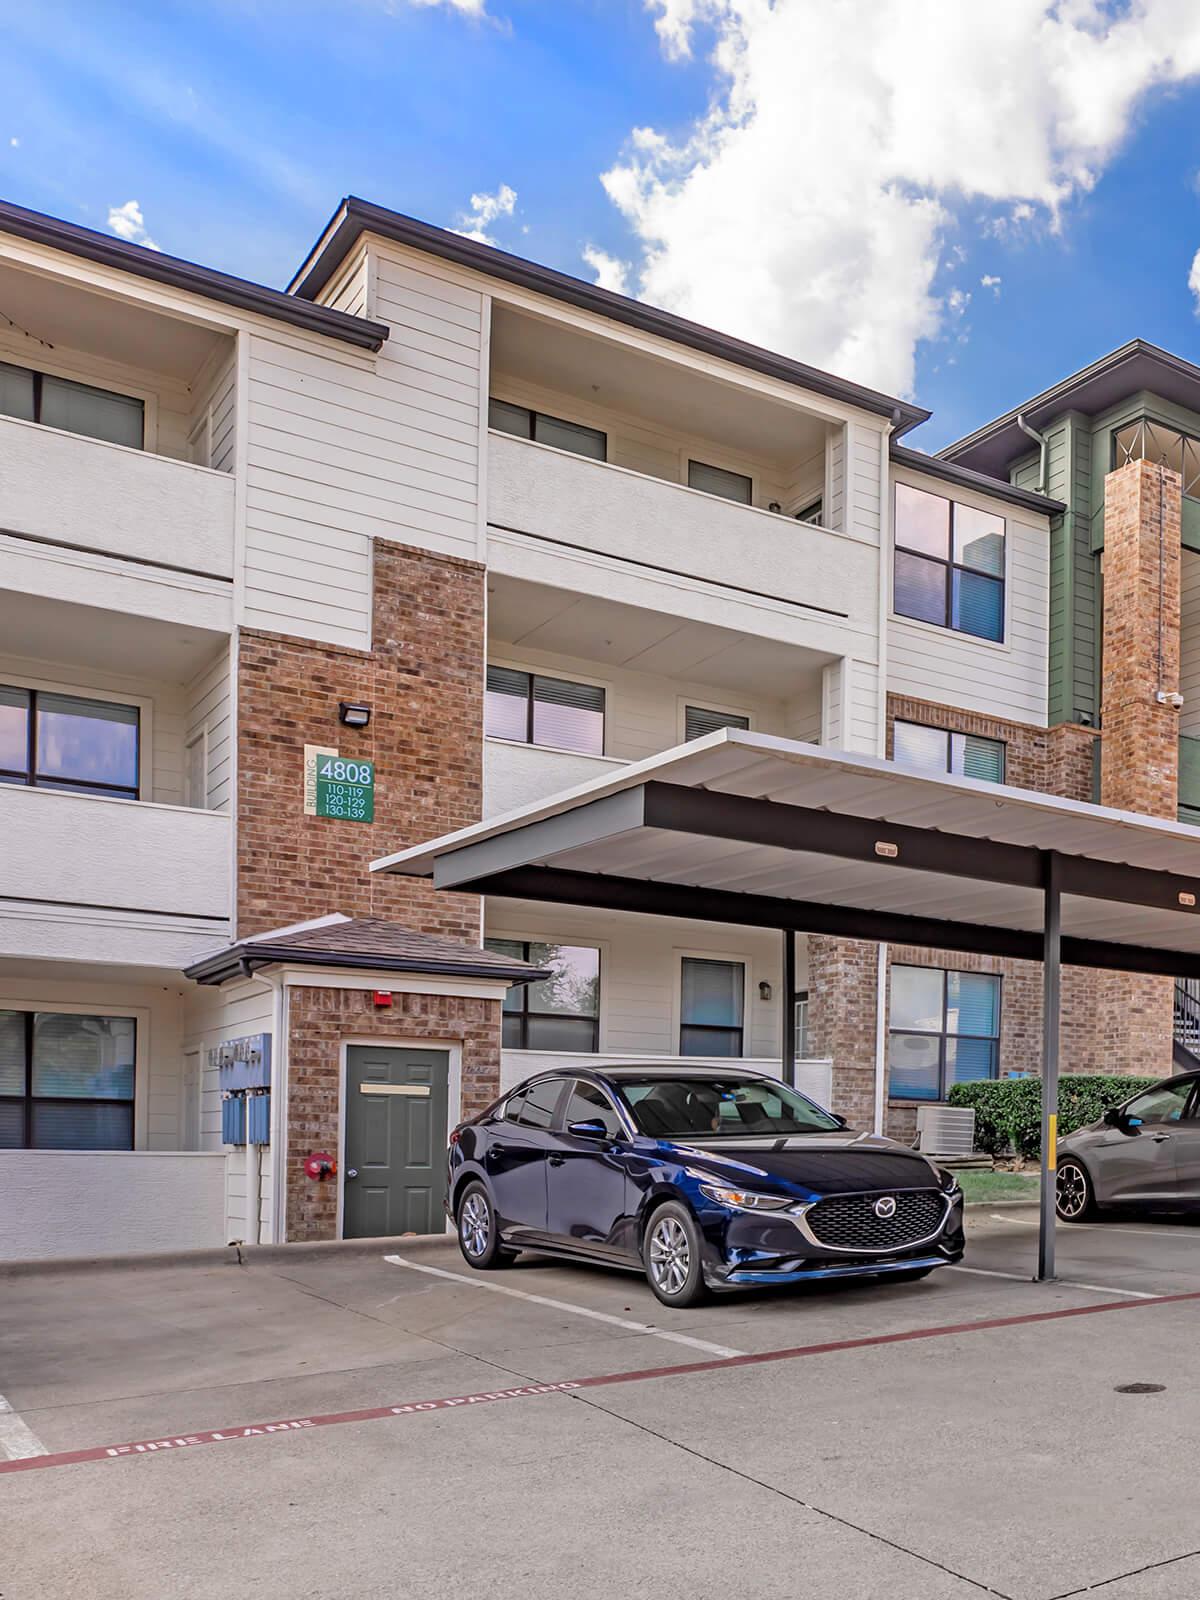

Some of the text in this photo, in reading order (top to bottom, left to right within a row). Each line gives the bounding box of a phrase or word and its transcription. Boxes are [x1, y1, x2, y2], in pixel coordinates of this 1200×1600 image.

[306, 759, 316, 807] BUILDING
[320, 760, 371, 784] 4808
[325, 793, 366, 809] 120-129
[328, 783, 364, 798] 110-119
[325, 804, 366, 819] 130-139
[391, 1381, 583, 1415] NO PARKING
[105, 1419, 317, 1457] FIRE LANE
